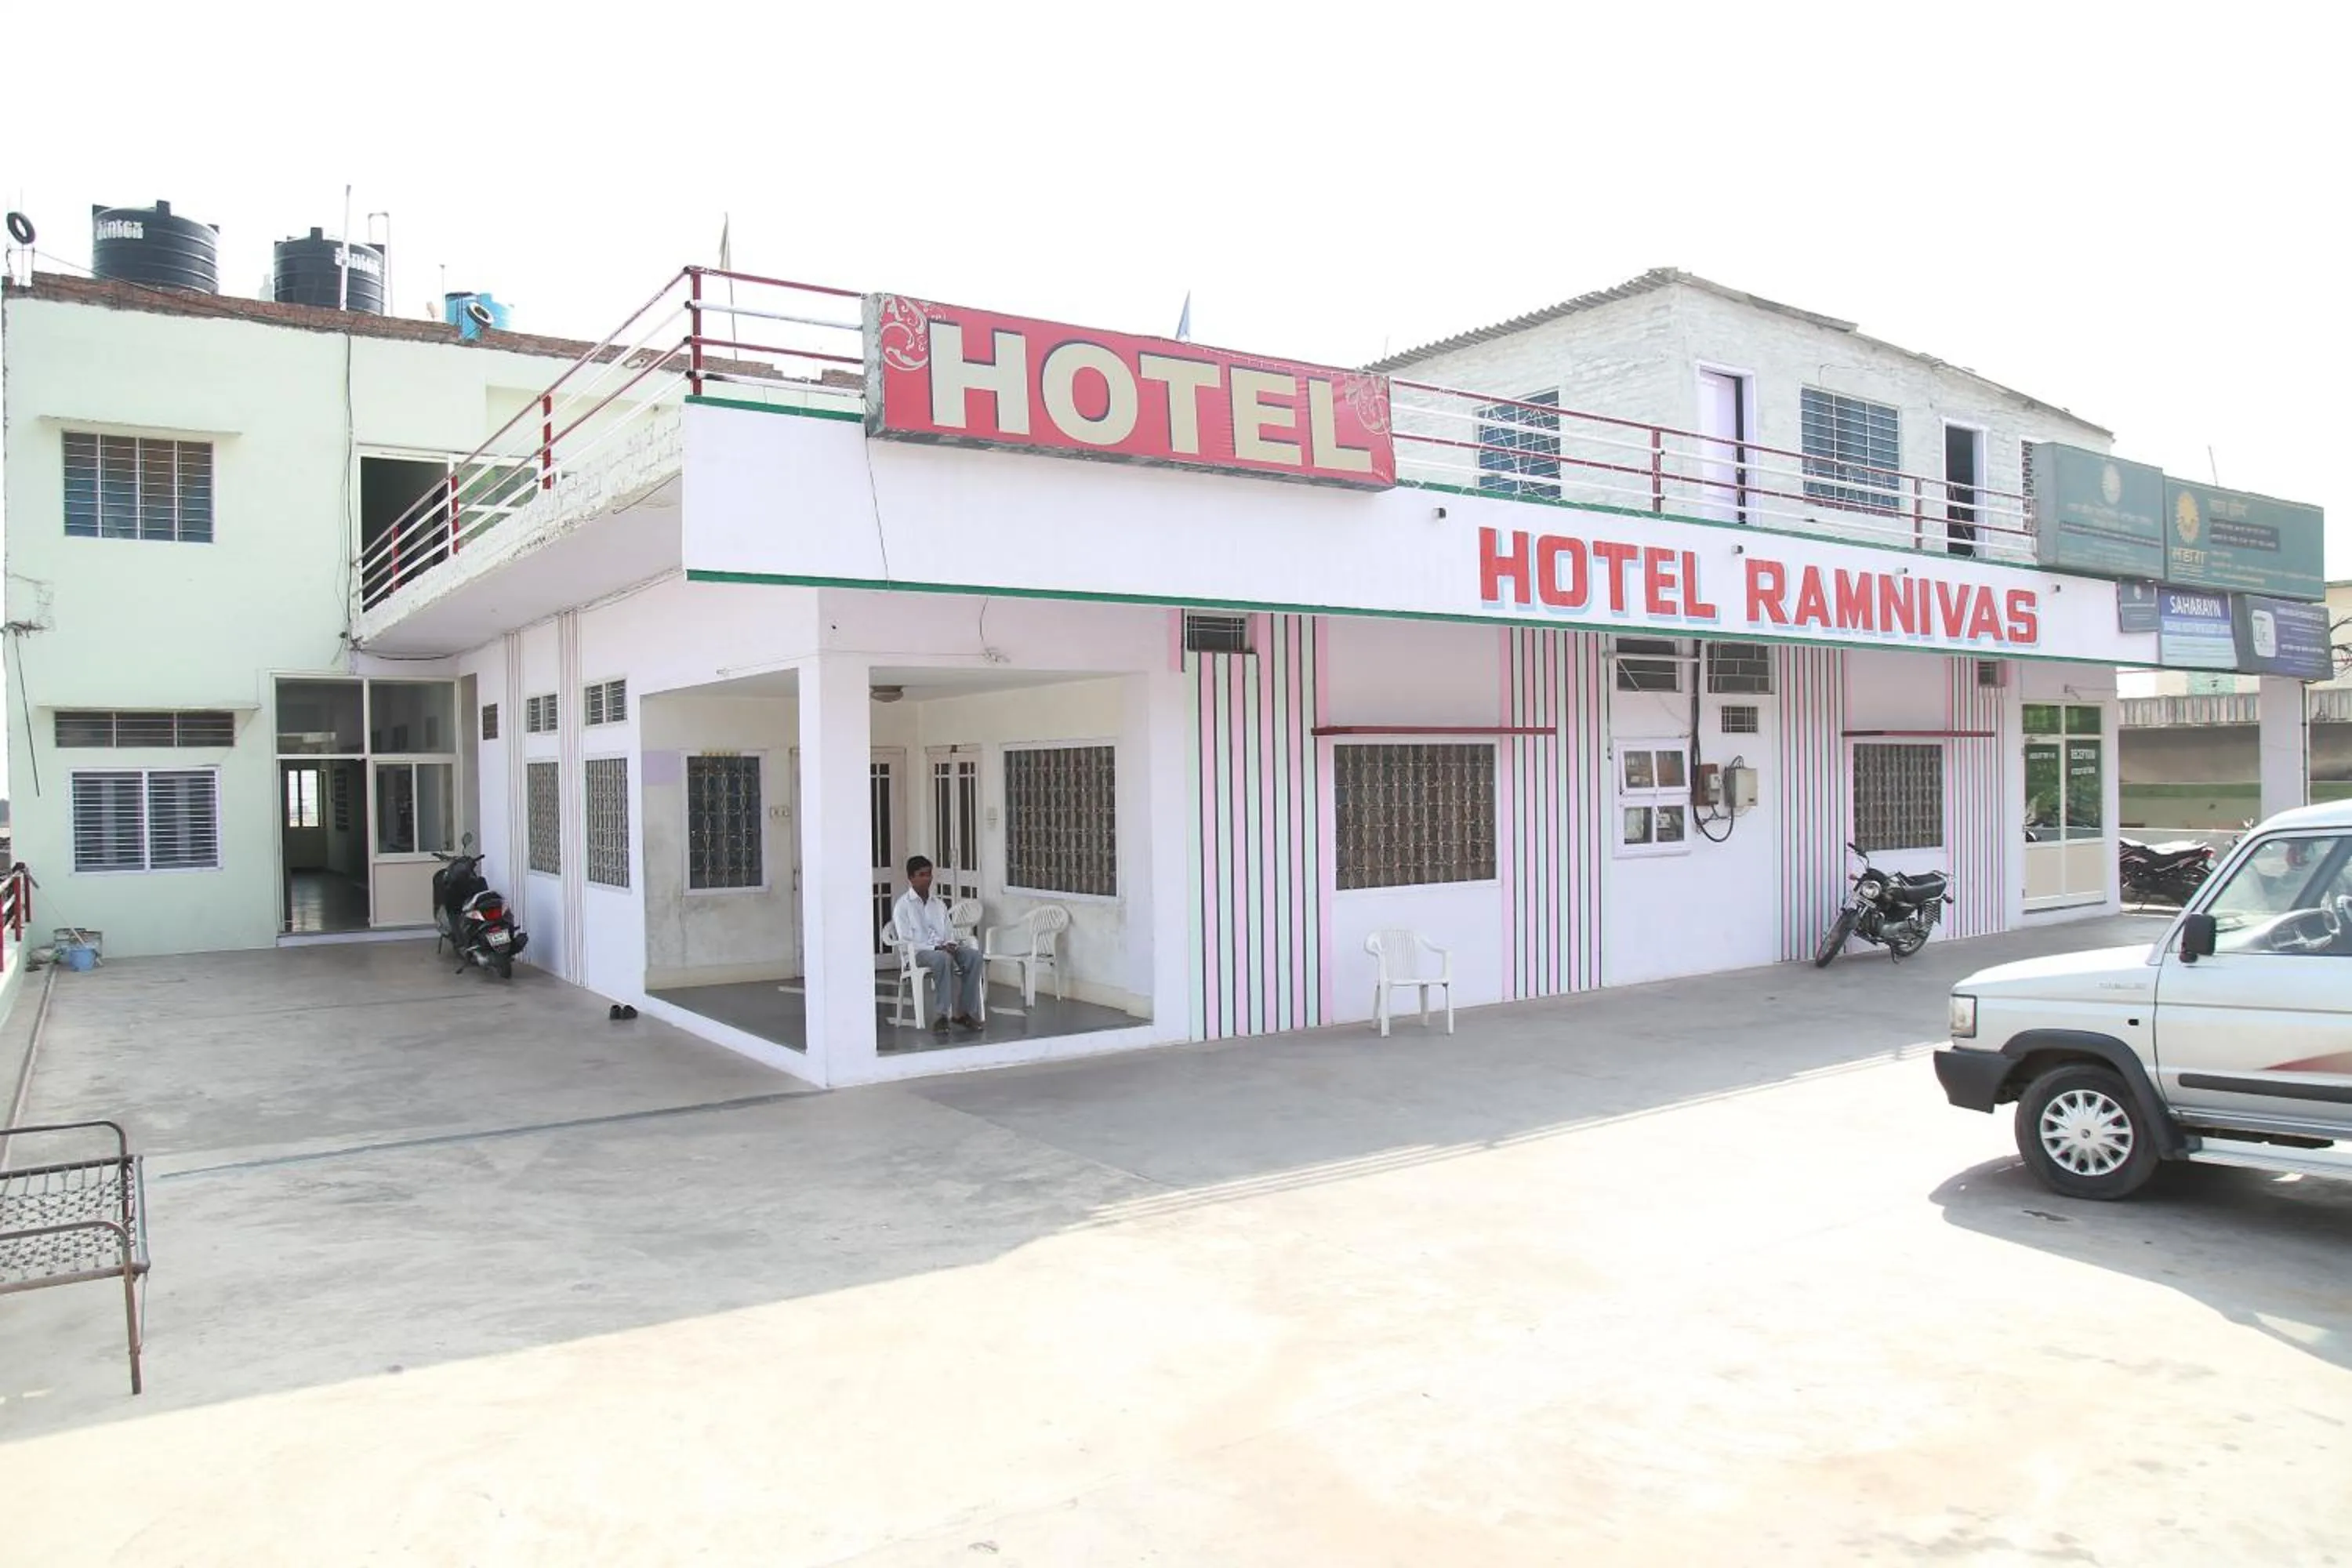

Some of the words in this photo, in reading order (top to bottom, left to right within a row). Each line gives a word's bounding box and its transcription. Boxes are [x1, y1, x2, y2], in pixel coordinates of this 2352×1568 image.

[929, 318, 1374, 475] HOTEL
[1479, 526, 1718, 619] HOTEL
[1746, 557, 2038, 644] RAMNIVAS
